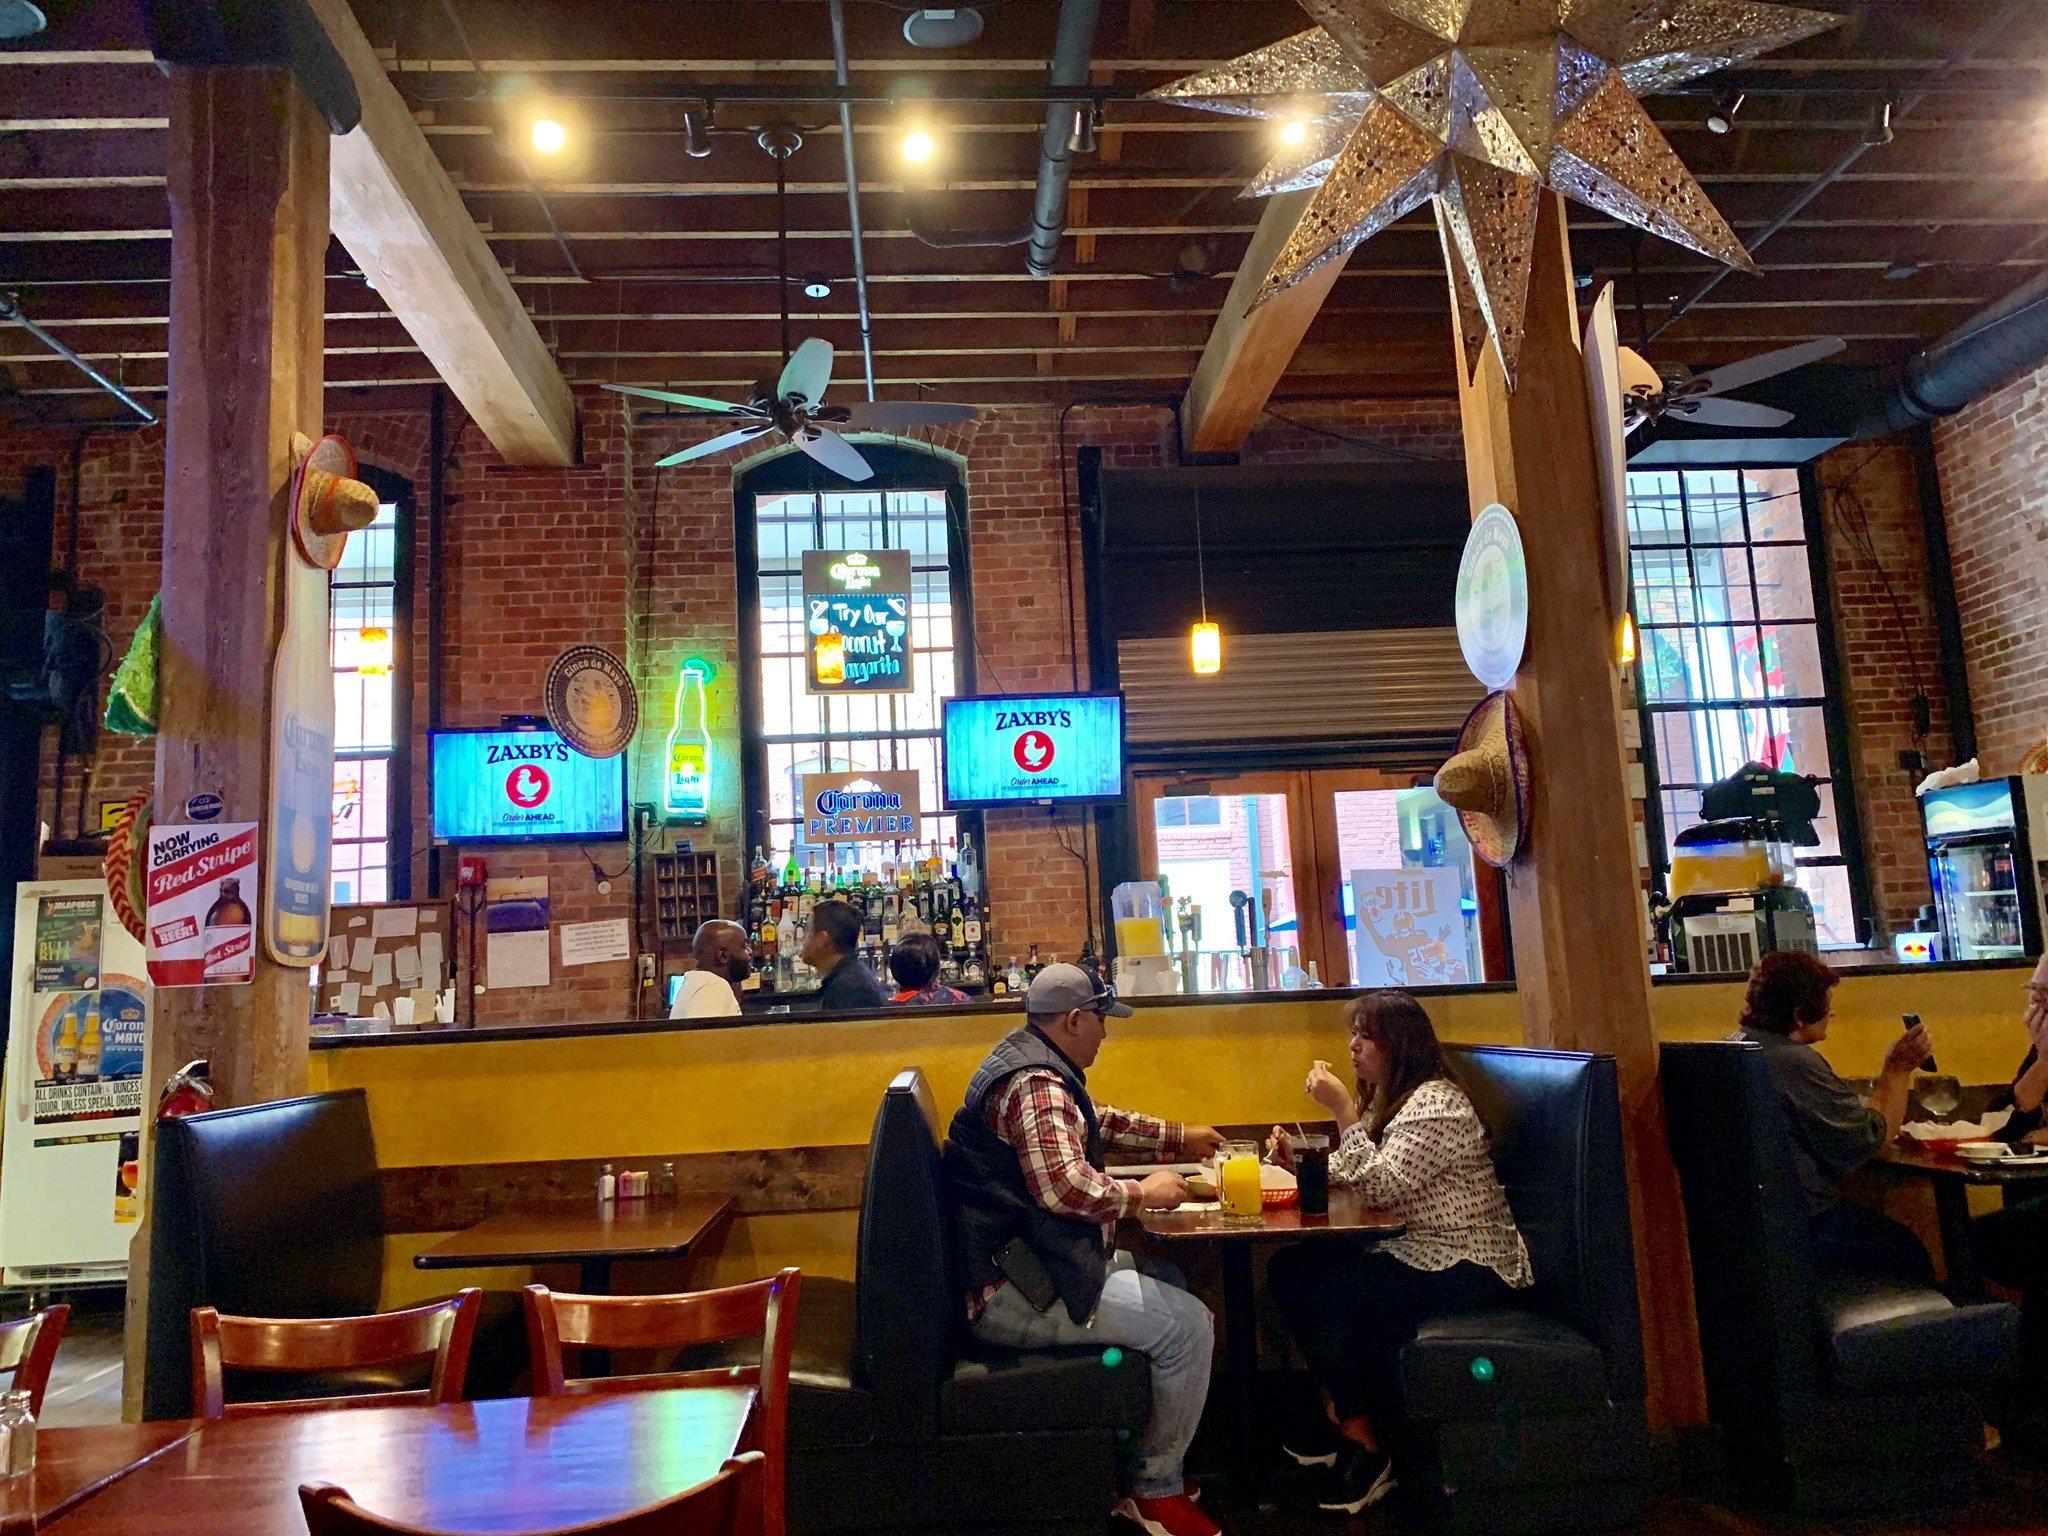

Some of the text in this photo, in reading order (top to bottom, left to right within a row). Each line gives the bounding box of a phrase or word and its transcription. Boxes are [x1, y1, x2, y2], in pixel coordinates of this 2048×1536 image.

[832, 602, 889, 628] Try Our
[829, 625, 887, 655] oconut
[564, 659, 623, 685] Cinco de Mayo
[843, 654, 900, 685] argarita
[995, 708, 1072, 731] ZAXBY'S
[487, 741, 569, 764] ZAXBY'S
[673, 754, 704, 762] Corona
[1031, 777, 1060, 785] AHEAD
[815, 789, 902, 818] Corona
[502, 812, 556, 822] Order AHEAD
[809, 815, 914, 836] PREMIER
[153, 830, 190, 856] NOW
[153, 833, 220, 867] CARRYING
[154, 841, 252, 895] Red Stripe
[160, 924, 195, 946] BEER!
[102, 1018, 144, 1033] Coron
[35, 1088, 47, 1100] ALL
[48, 1085, 72, 1099] DRINKS
[74, 1083, 101, 1098] CONTAIN
[113, 1081, 139, 1094] OUNCES
[61, 1098, 86, 1112] UNLESS
[88, 1096, 115, 1110] SPECIAL
[116, 1093, 142, 1106] ORDERE
